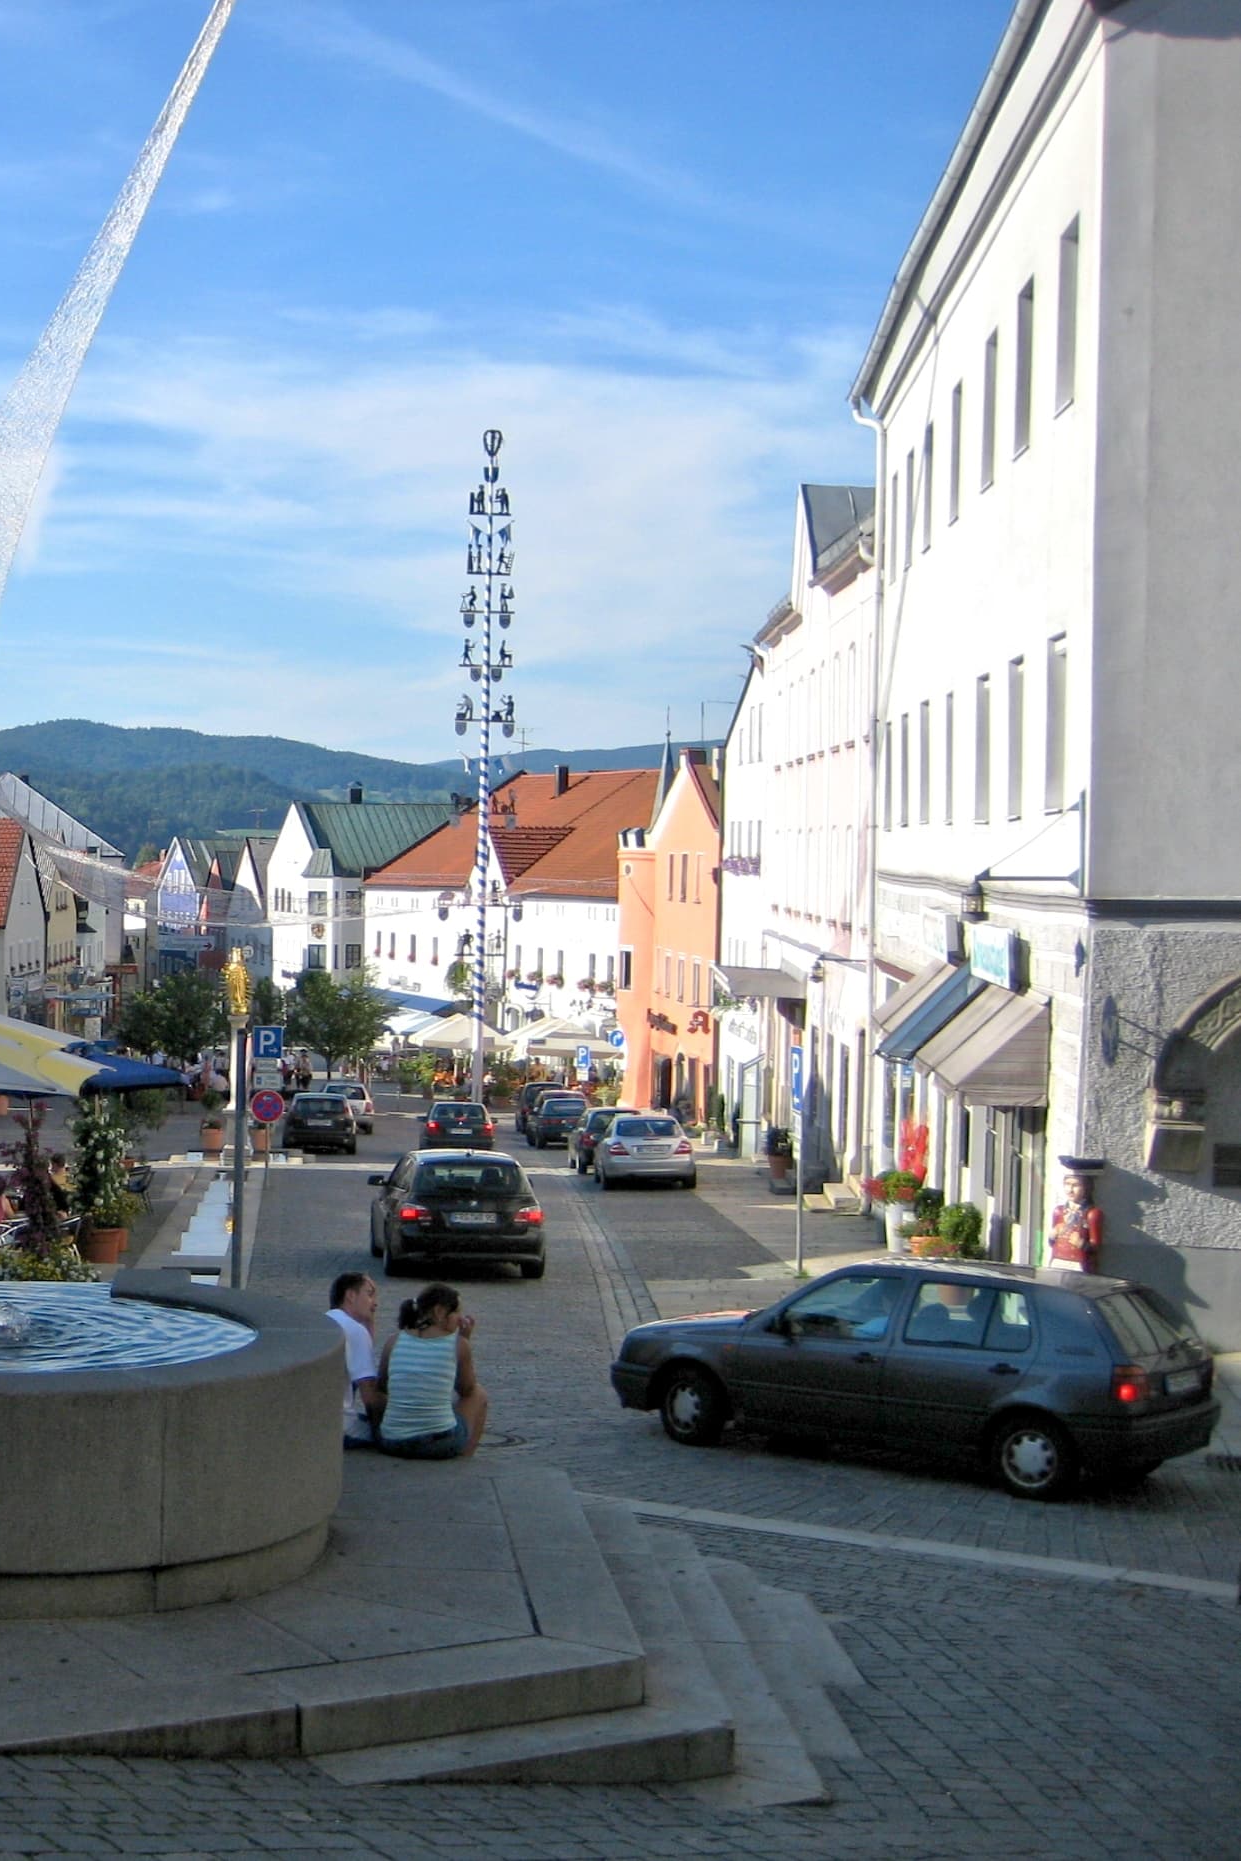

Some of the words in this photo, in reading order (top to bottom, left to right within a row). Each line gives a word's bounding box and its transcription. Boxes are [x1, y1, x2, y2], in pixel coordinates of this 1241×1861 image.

[260, 1030, 275, 1055] P
[579, 1047, 587, 1062] P
[792, 1053, 800, 1089] P
